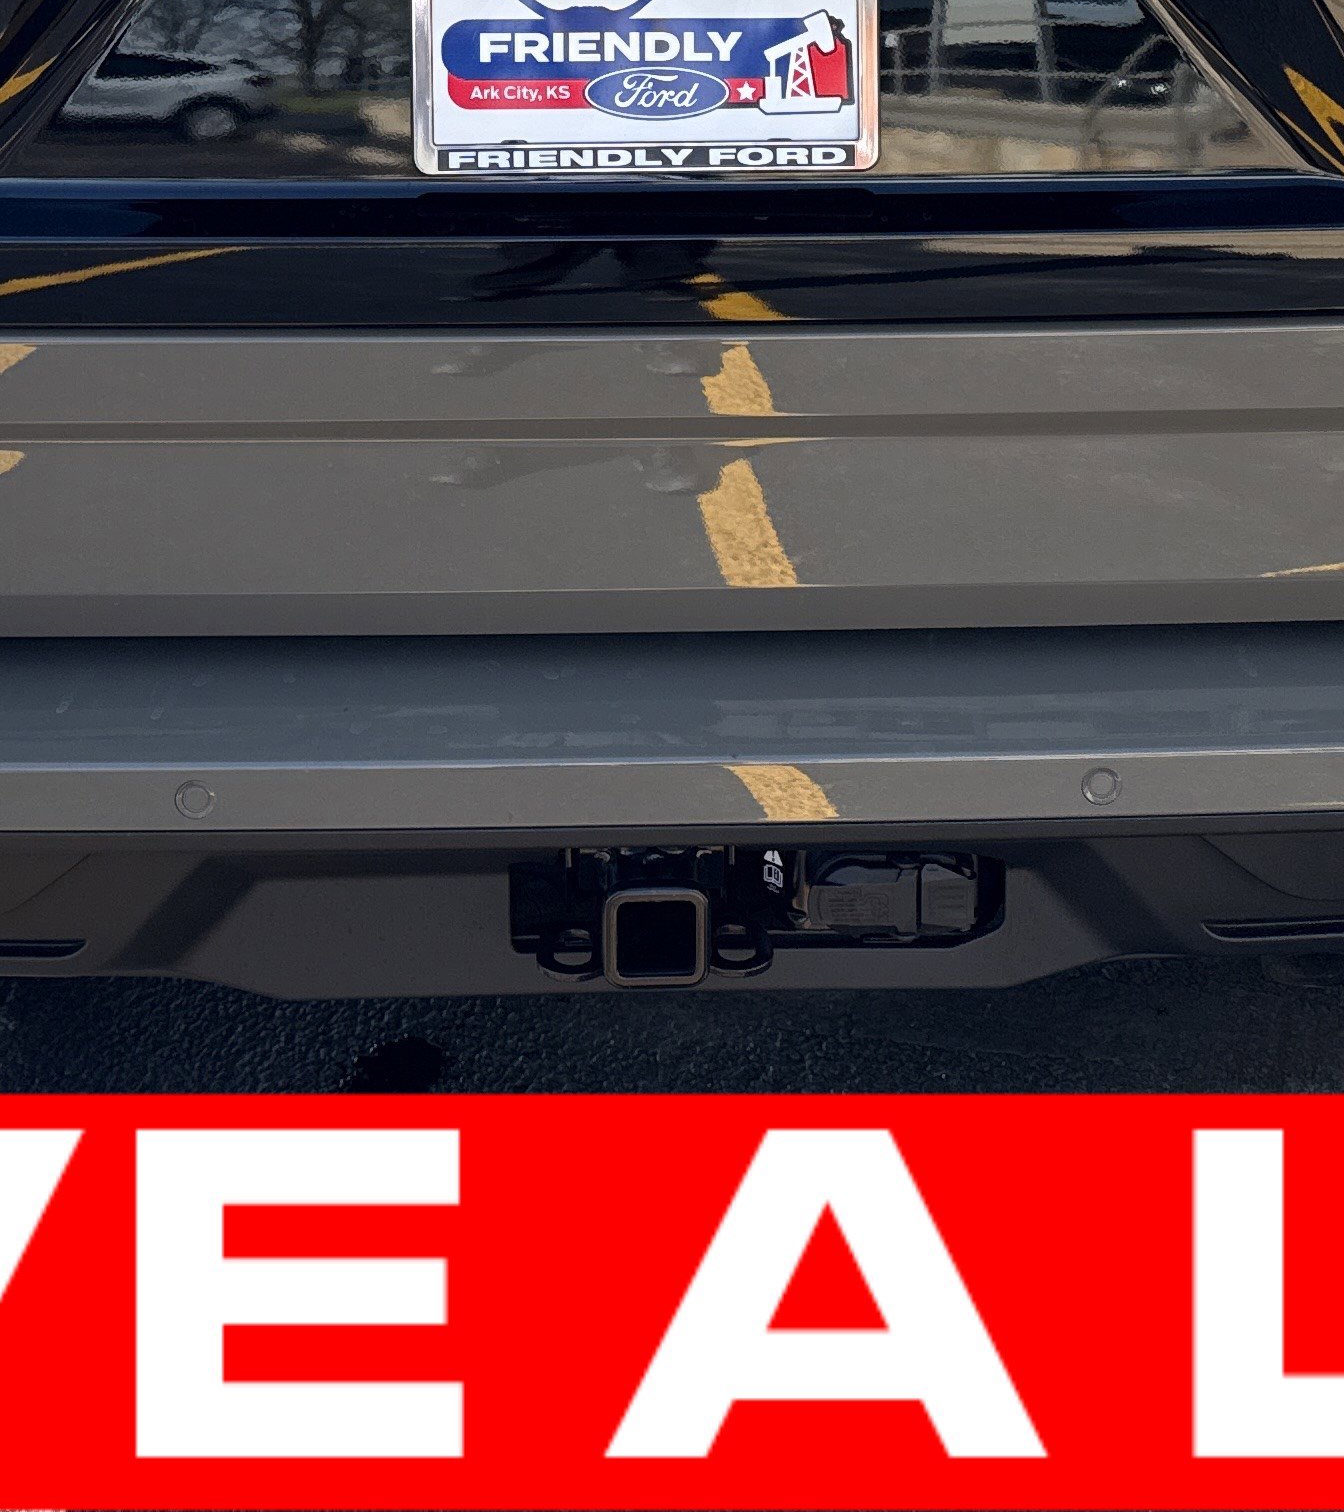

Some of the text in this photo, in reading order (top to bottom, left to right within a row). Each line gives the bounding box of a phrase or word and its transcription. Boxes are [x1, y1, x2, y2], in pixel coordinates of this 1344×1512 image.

[478, 31, 743, 64] FRIENDLY
[469, 84, 571, 103] Ark City, KS
[613, 73, 699, 109] Ford
[448, 146, 849, 169] FRIENDLY FORD
